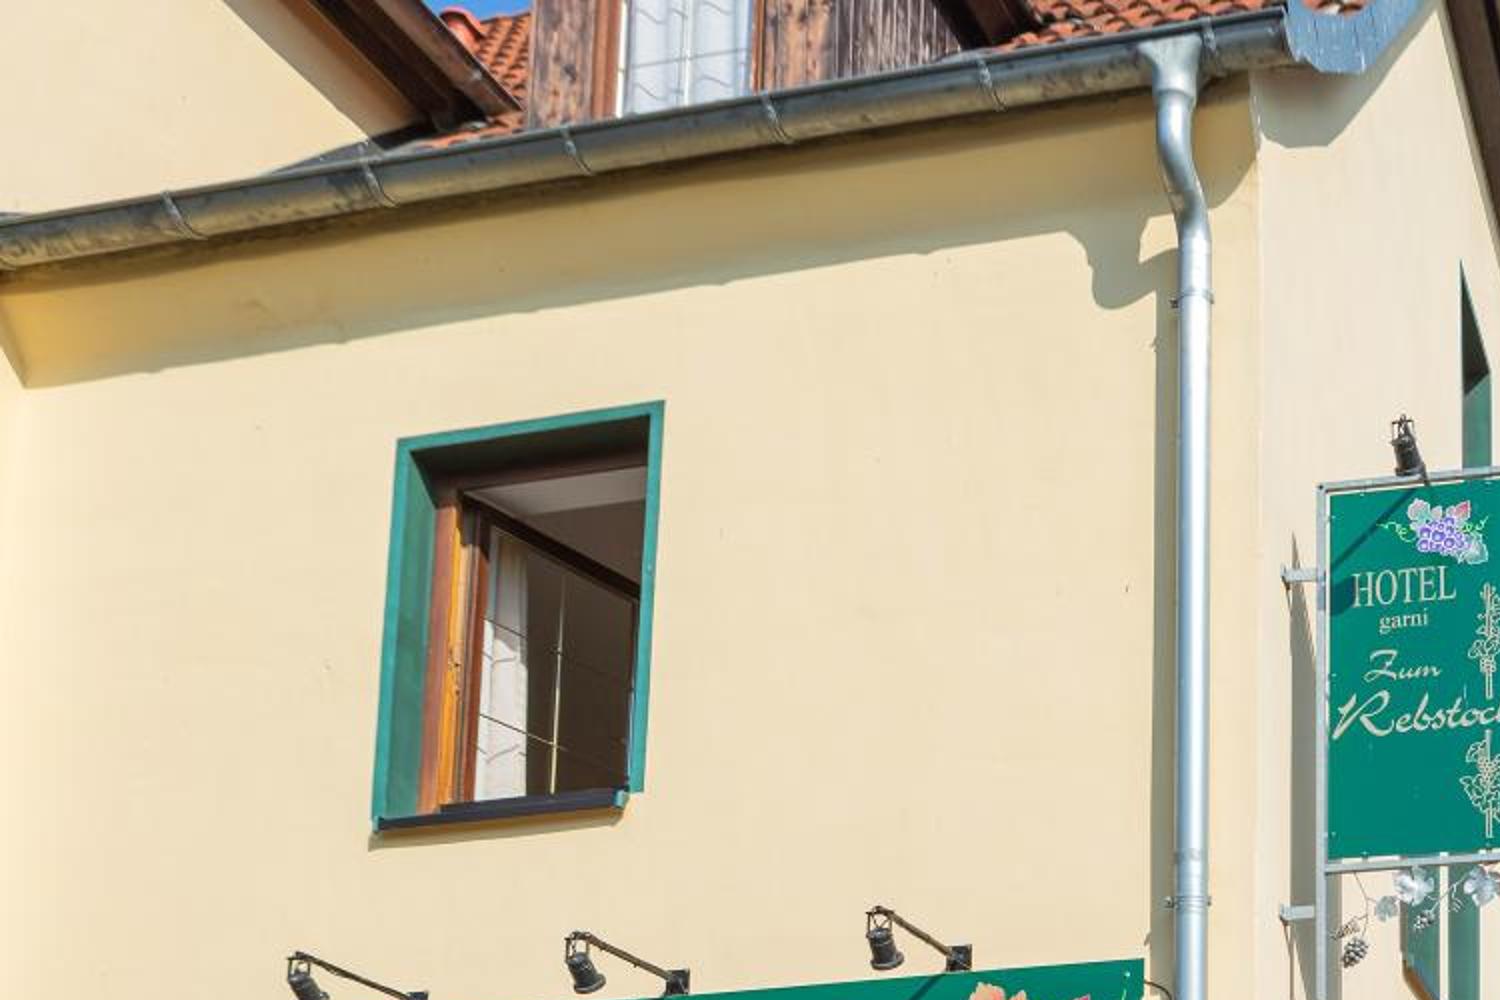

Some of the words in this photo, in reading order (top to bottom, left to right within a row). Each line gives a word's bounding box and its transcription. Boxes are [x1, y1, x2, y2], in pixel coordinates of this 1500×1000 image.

[1352, 565, 1457, 608] HOTEL
[1378, 607, 1429, 634] garni
[1363, 648, 1441, 682] Zum
